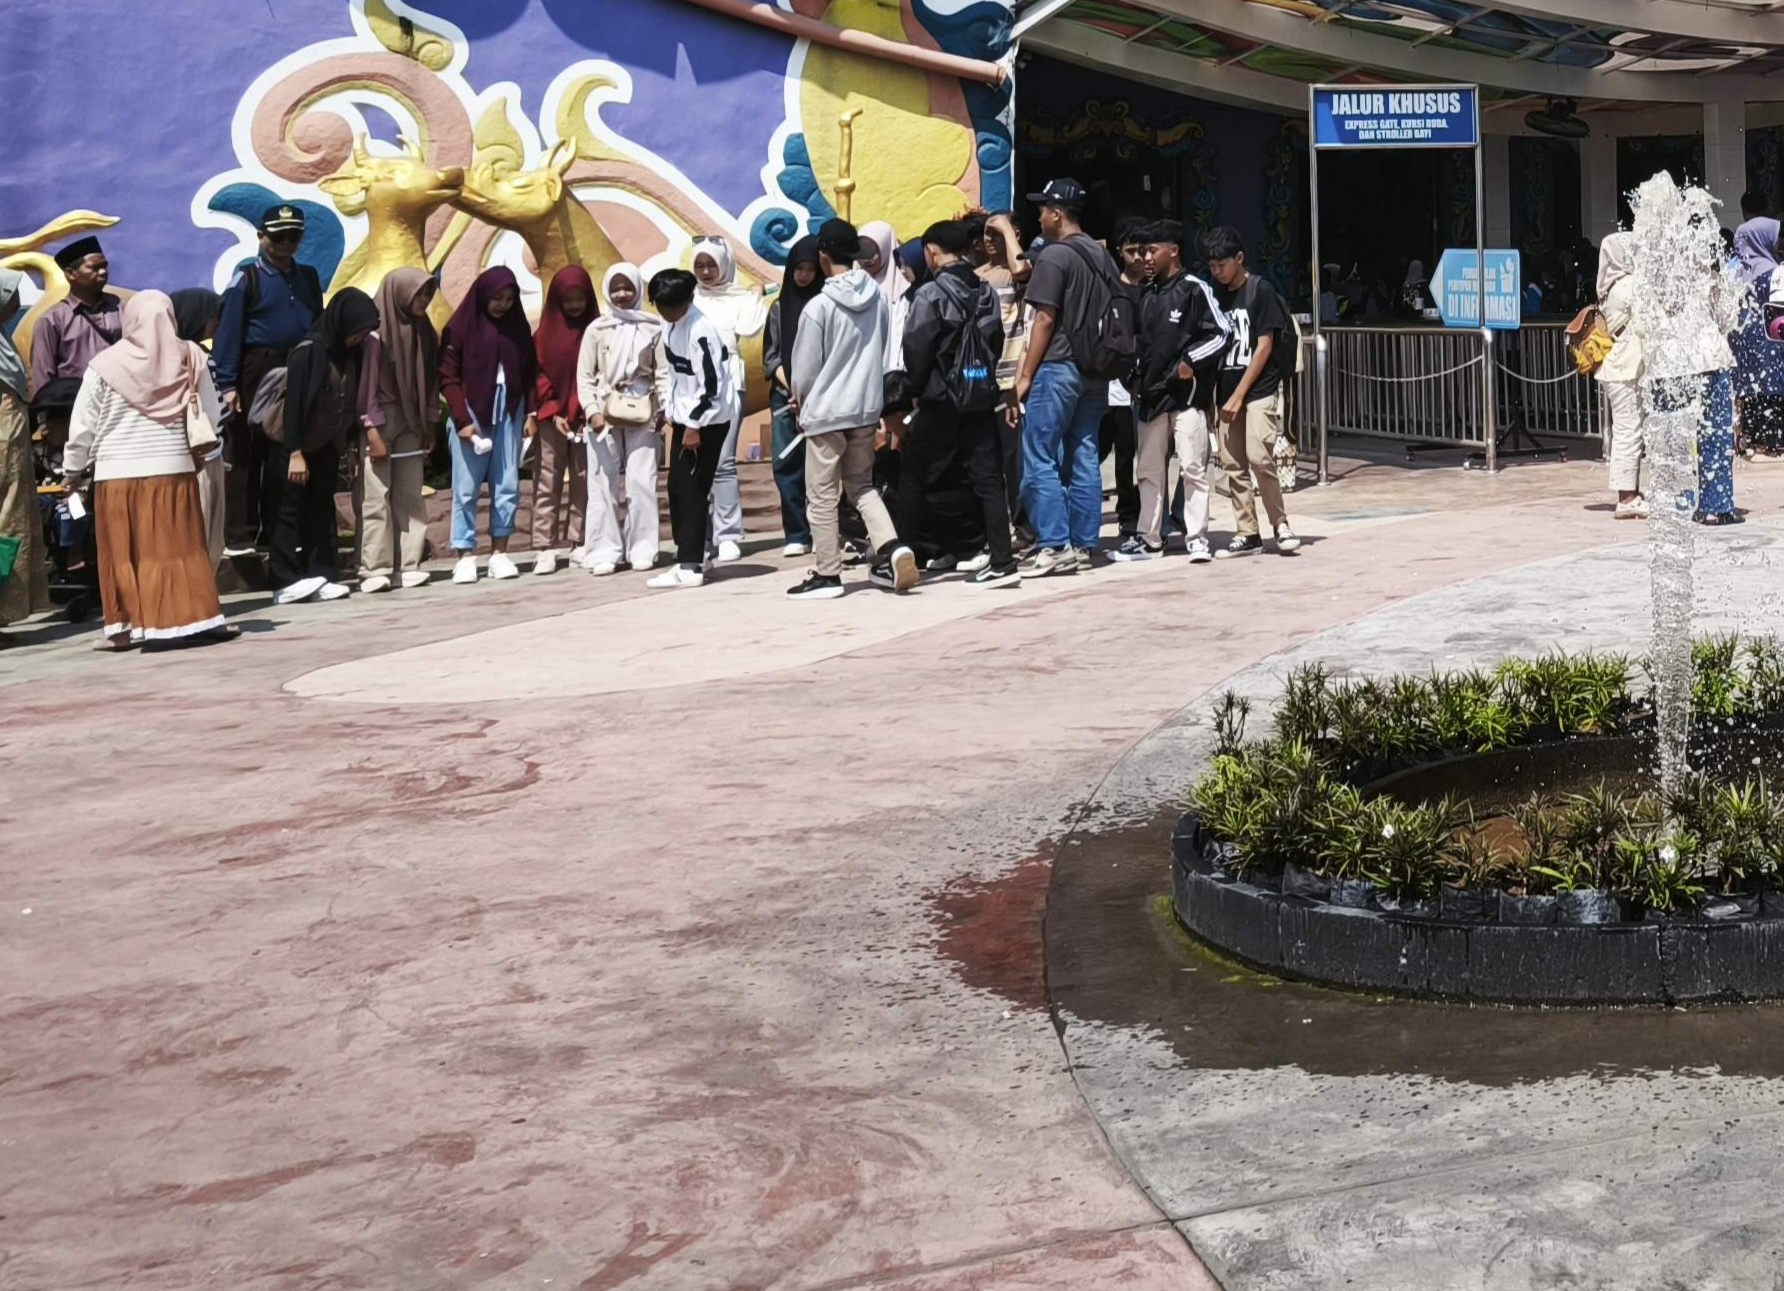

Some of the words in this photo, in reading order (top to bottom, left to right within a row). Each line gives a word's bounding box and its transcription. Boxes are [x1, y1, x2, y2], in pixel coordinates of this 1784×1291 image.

[1332, 94, 1384, 115] JALUR
[1389, 93, 1461, 114] KHUSUS
[1345, 119, 1378, 130] EXPRESS
[1376, 129, 1412, 139] STROLLER
[1448, 294, 1458, 318] DI
